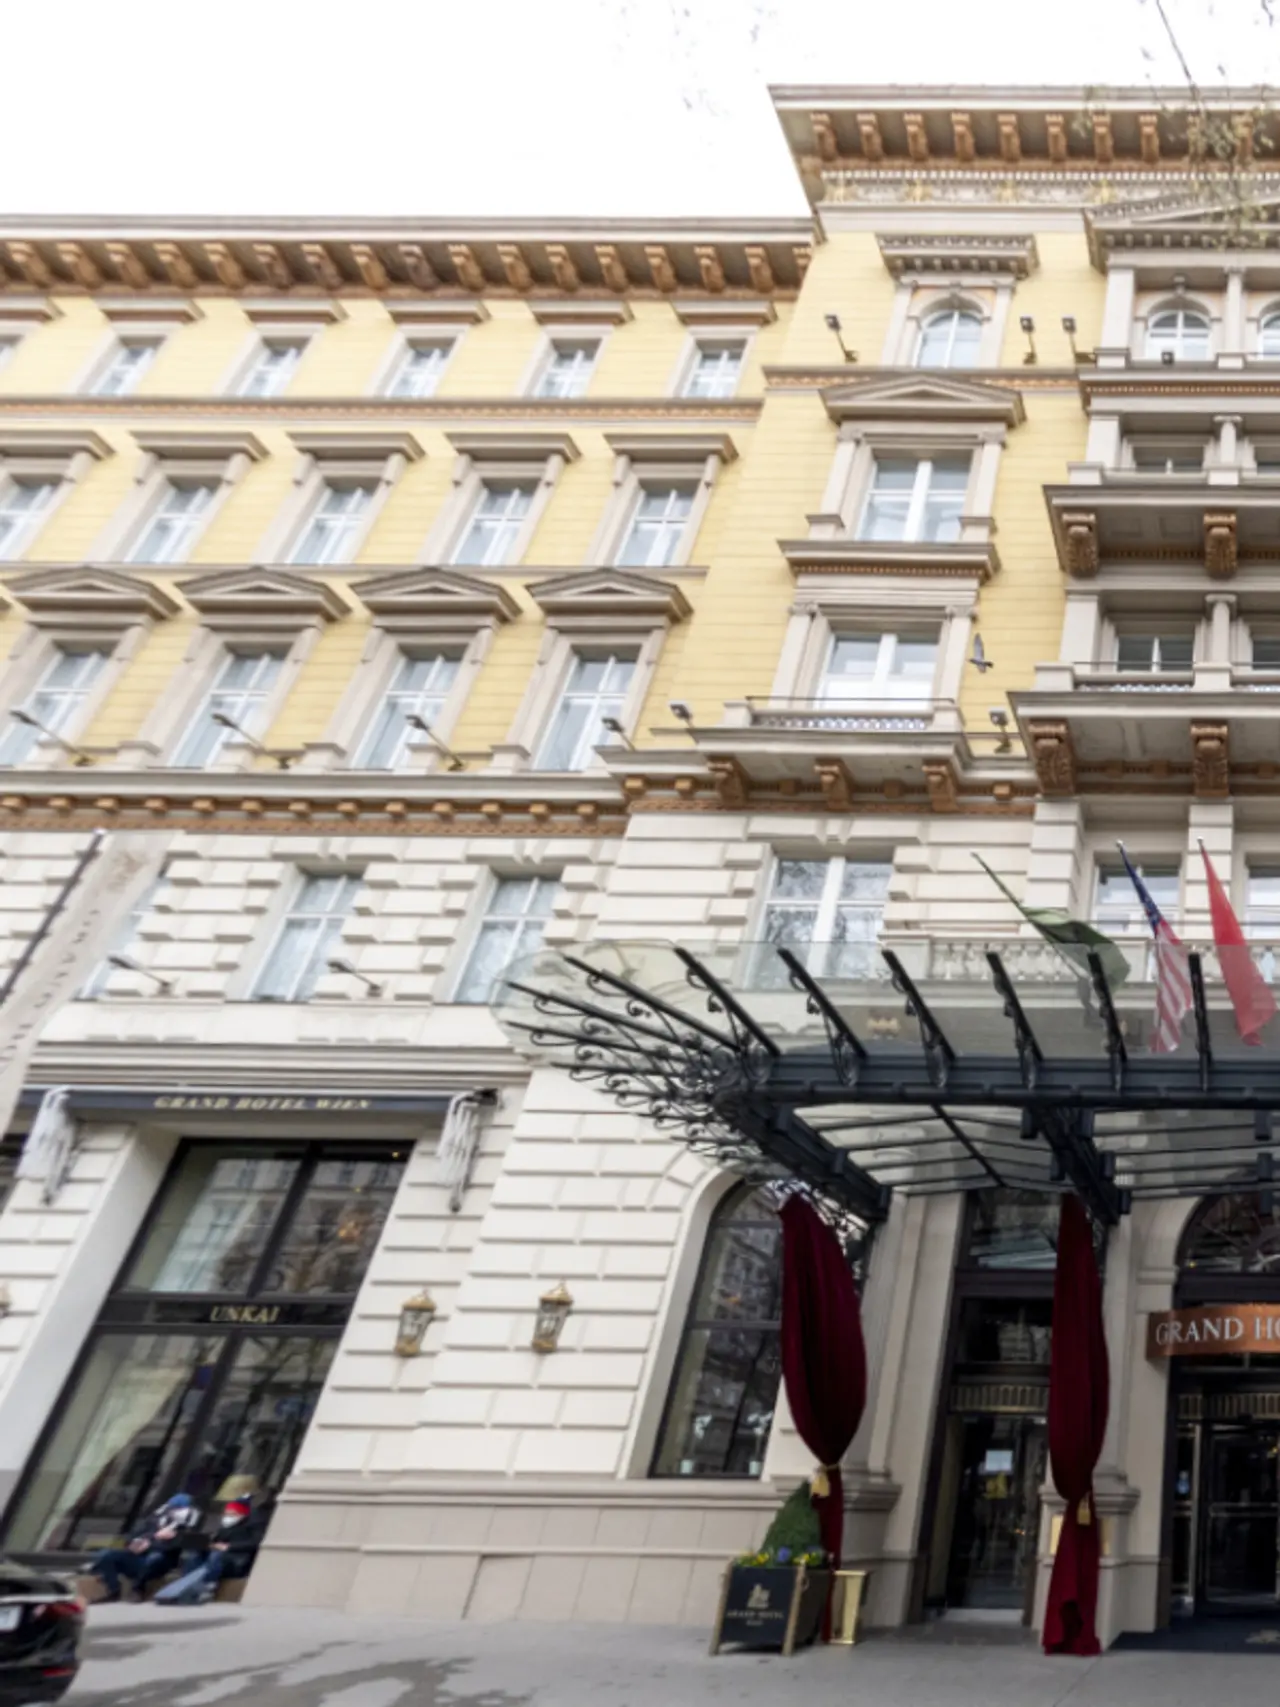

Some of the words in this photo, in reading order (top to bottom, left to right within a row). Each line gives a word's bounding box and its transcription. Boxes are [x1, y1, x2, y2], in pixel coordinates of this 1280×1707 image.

[153, 1097, 230, 1109] GRAND
[234, 1098, 308, 1110] HOTEL
[315, 1099, 372, 1110] WIEN
[210, 1305, 281, 1323] UNKAI
[1156, 1317, 1244, 1346] GRAND
